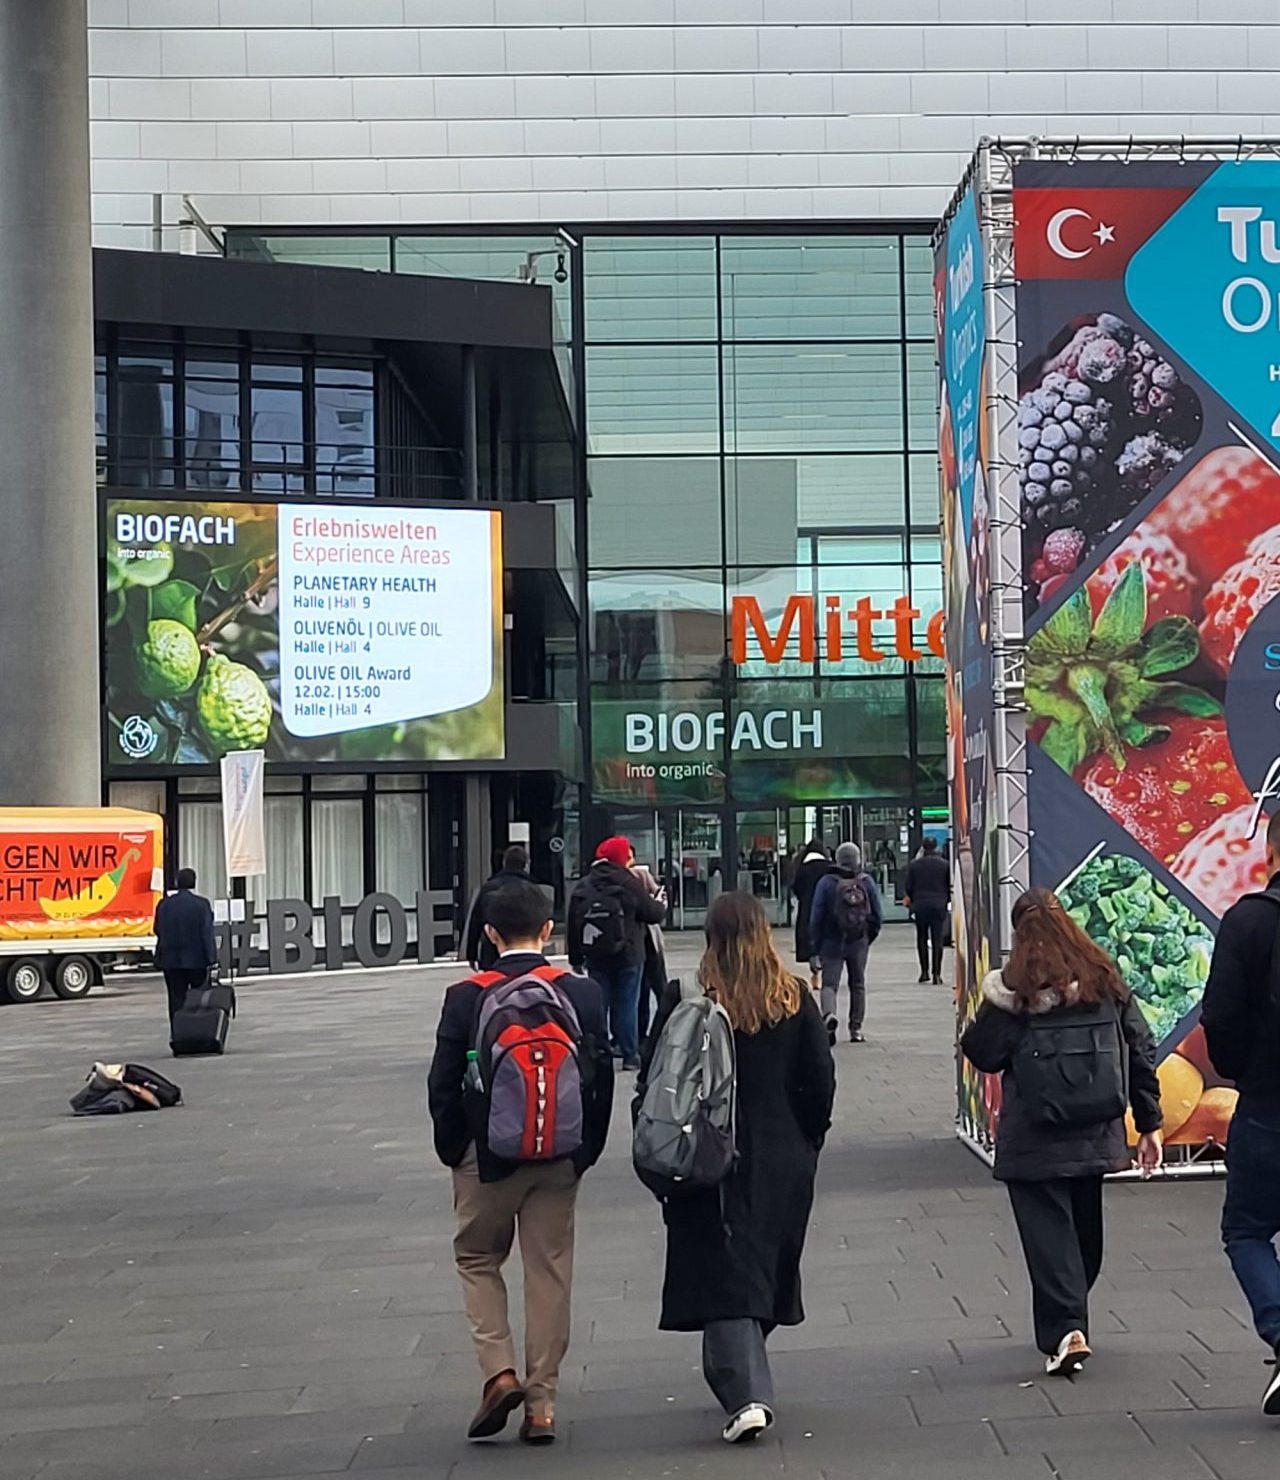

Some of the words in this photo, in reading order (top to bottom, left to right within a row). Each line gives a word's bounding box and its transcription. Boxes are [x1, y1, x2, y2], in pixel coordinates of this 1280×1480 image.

[116, 513, 235, 545] BIOFACH
[292, 517, 437, 541] Erlebniswelten
[117, 547, 136, 558] into
[136, 549, 171, 561] organic
[292, 541, 395, 567] Experience
[399, 545, 451, 565] Areas
[293, 575, 378, 592] PLANETARY
[381, 576, 437, 593] HEALTH
[293, 595, 325, 609] Halle
[334, 595, 357, 609] Hall
[362, 596, 371, 609] 9
[294, 617, 365, 636] OLIVENÖL
[376, 621, 417, 637] OLIVE
[420, 622, 443, 637] OIL
[294, 640, 325, 654] Halle
[335, 641, 357, 654] Hall
[362, 641, 371, 654] 4
[294, 665, 336, 681] OLIVE
[340, 665, 363, 681] OIL
[366, 665, 411, 681] Award
[295, 685, 335, 699] 12.02.
[345, 685, 381, 699] 15:00
[294, 703, 326, 716] Halle
[336, 703, 358, 716] Hall
[364, 703, 372, 716] 4
[625, 709, 823, 753] BIOFACH
[626, 762, 656, 778] into
[659, 761, 714, 780] organic
[4, 845, 60, 869] GEN
[69, 844, 118, 868] WIR
[0, 877, 44, 901] HT
[53, 876, 103, 900] MIT.
